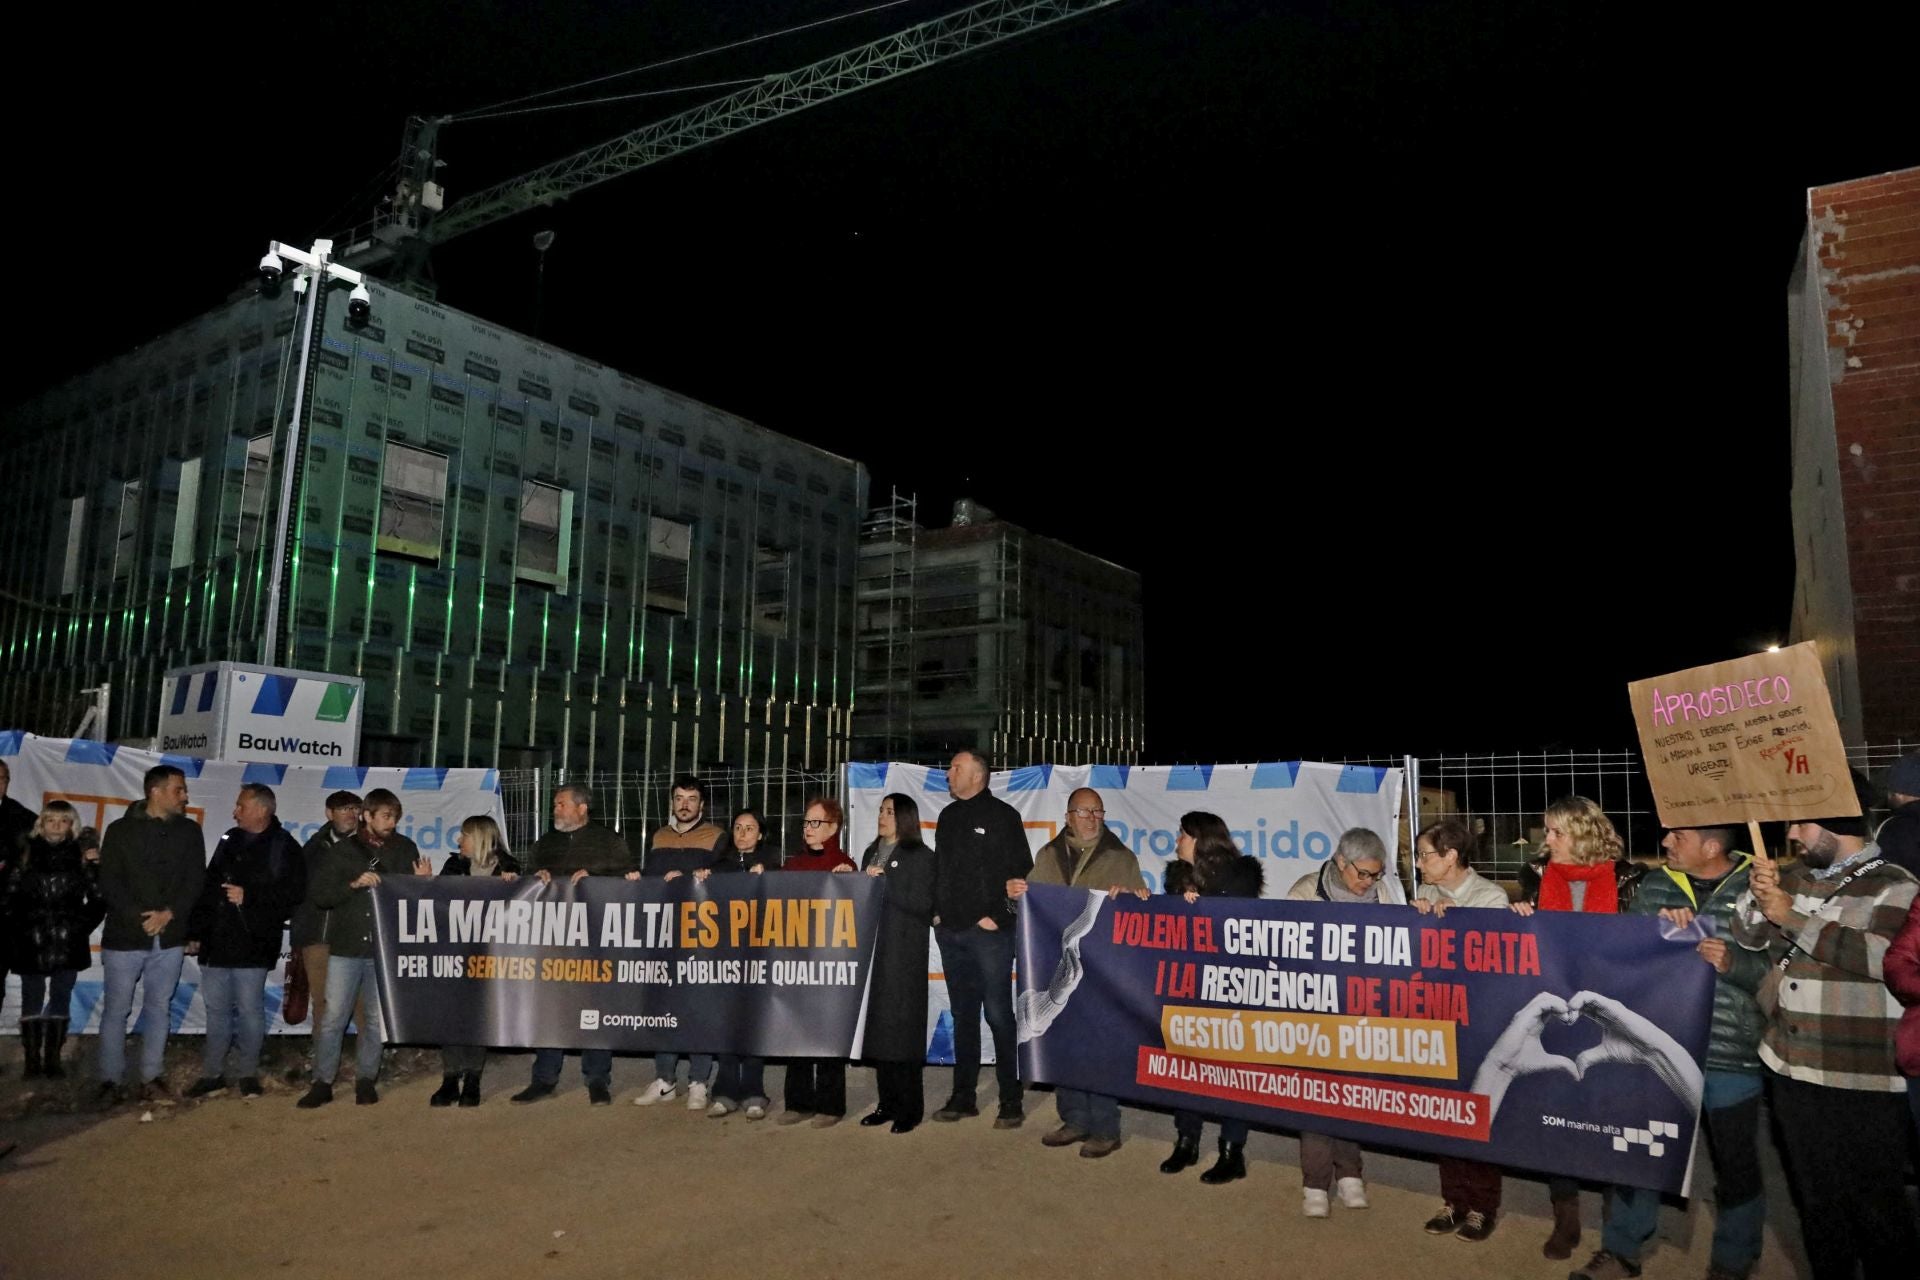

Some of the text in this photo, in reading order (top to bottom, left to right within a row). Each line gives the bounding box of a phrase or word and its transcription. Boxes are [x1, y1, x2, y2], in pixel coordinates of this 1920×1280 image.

[1653, 675, 1791, 727] APROSDECO
[163, 733, 208, 750] BauWatch
[239, 733, 342, 757] BauWatch
[1784, 748, 1810, 775] YA
[1852, 859, 1885, 877] umbro
[398, 899, 857, 949] LA MARINA ALTA ES PLANTA
[1112, 911, 1541, 977] VOLEM EL CENTRE DE DIA DE GATA
[397, 955, 428, 978] PER
[432, 955, 464, 978] UNS
[467, 955, 536, 981] SERVEIS
[541, 958, 613, 983] SOCIALS
[617, 960, 673, 987] DIGNES,
[676, 955, 741, 984] PÚBLICS
[749, 960, 767, 984] DE
[771, 960, 859, 986] QUALITAT
[1154, 960, 1470, 1026] I LA RESIDÈNCIA DE DÉNIA
[602, 1013, 679, 1031] compromís
[1169, 1012, 1447, 1066] GESTIÓ 100% PÚBLICA
[1148, 1054, 1477, 1126] NO A LA PRIVATITZACIÓ DELS SERVEIS SOCIALS
[1542, 1115, 1621, 1135] SOM marina alta
